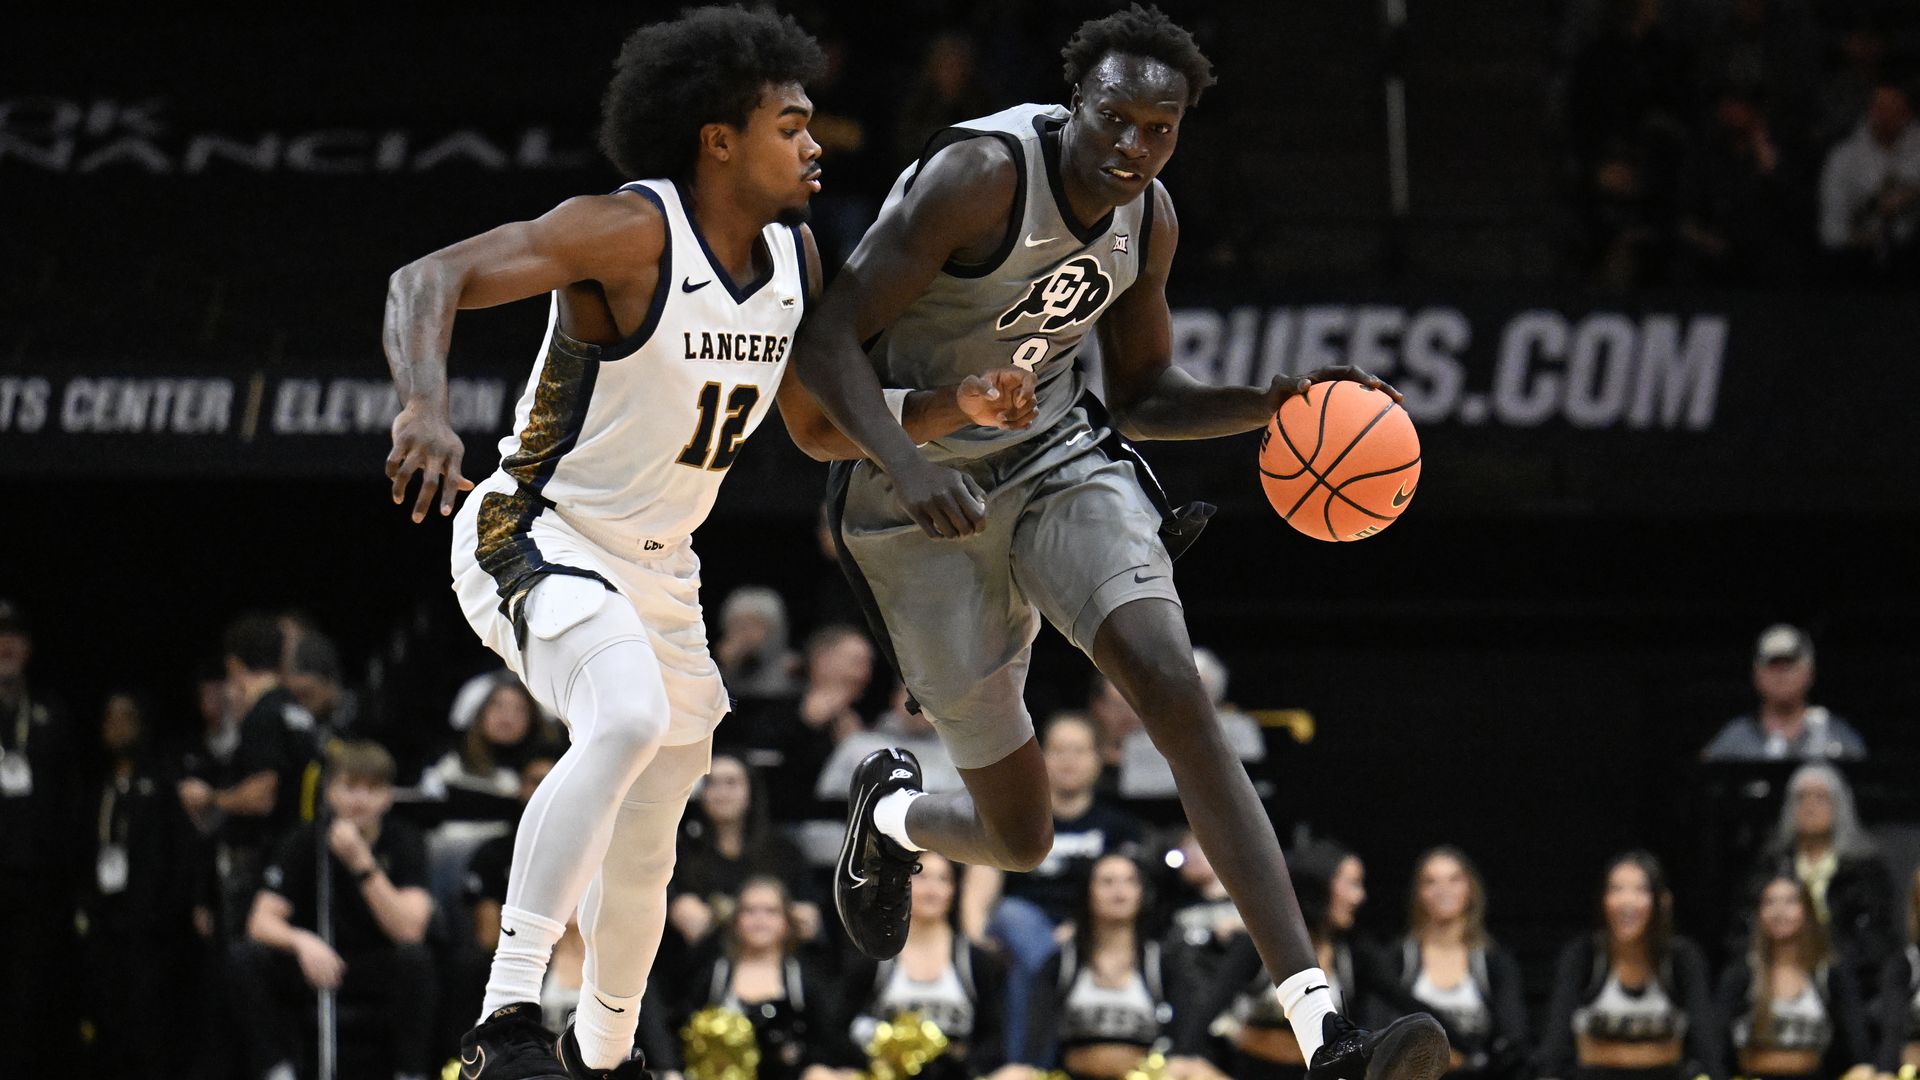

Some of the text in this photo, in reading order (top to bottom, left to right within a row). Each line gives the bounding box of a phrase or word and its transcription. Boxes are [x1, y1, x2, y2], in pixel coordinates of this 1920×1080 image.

[683, 332, 788, 363] LANCERS
[1080, 303, 1730, 431] BUFFS.COM
[60, 376, 235, 434] CENTER
[270, 377, 507, 435] ELEVAON
[675, 381, 760, 472] 12
